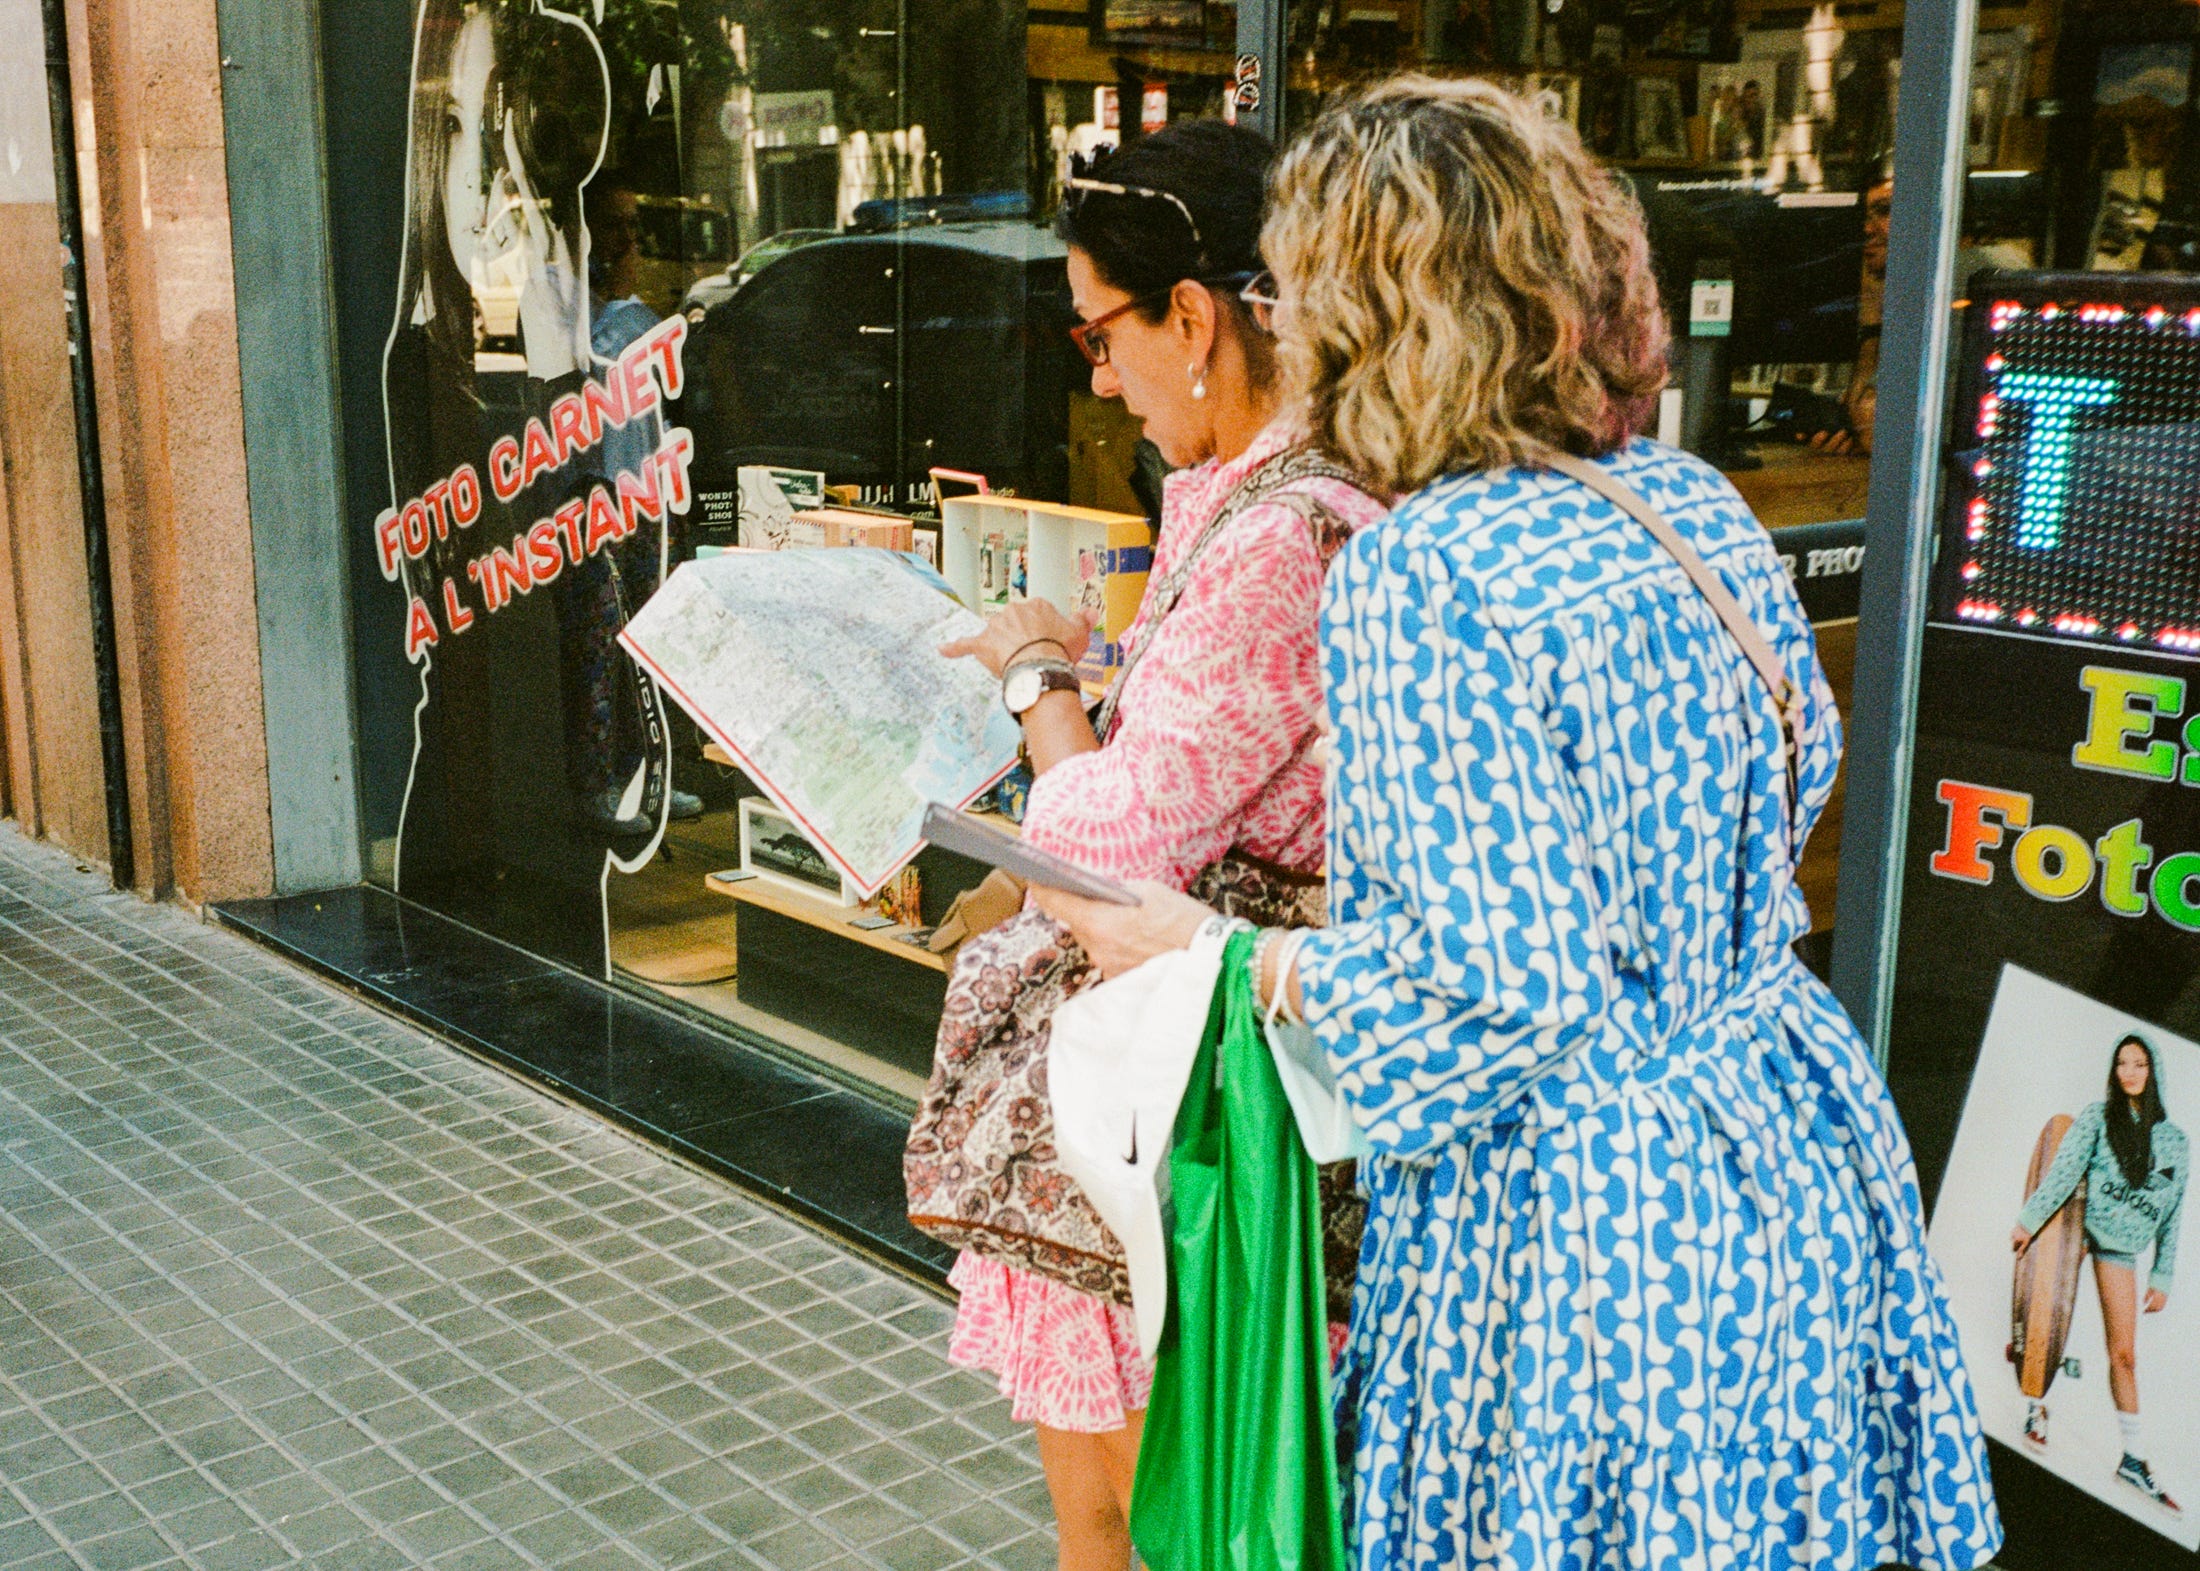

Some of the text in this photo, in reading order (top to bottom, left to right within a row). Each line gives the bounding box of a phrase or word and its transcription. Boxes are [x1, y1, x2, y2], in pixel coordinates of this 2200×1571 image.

[378, 321, 685, 574] FOTO CARNET
[1999, 371, 2116, 550] T
[704, 501, 733, 511] PHOT
[1805, 545, 1866, 579] PHO
[407, 597, 440, 657] A
[2072, 664, 2200, 788] E
